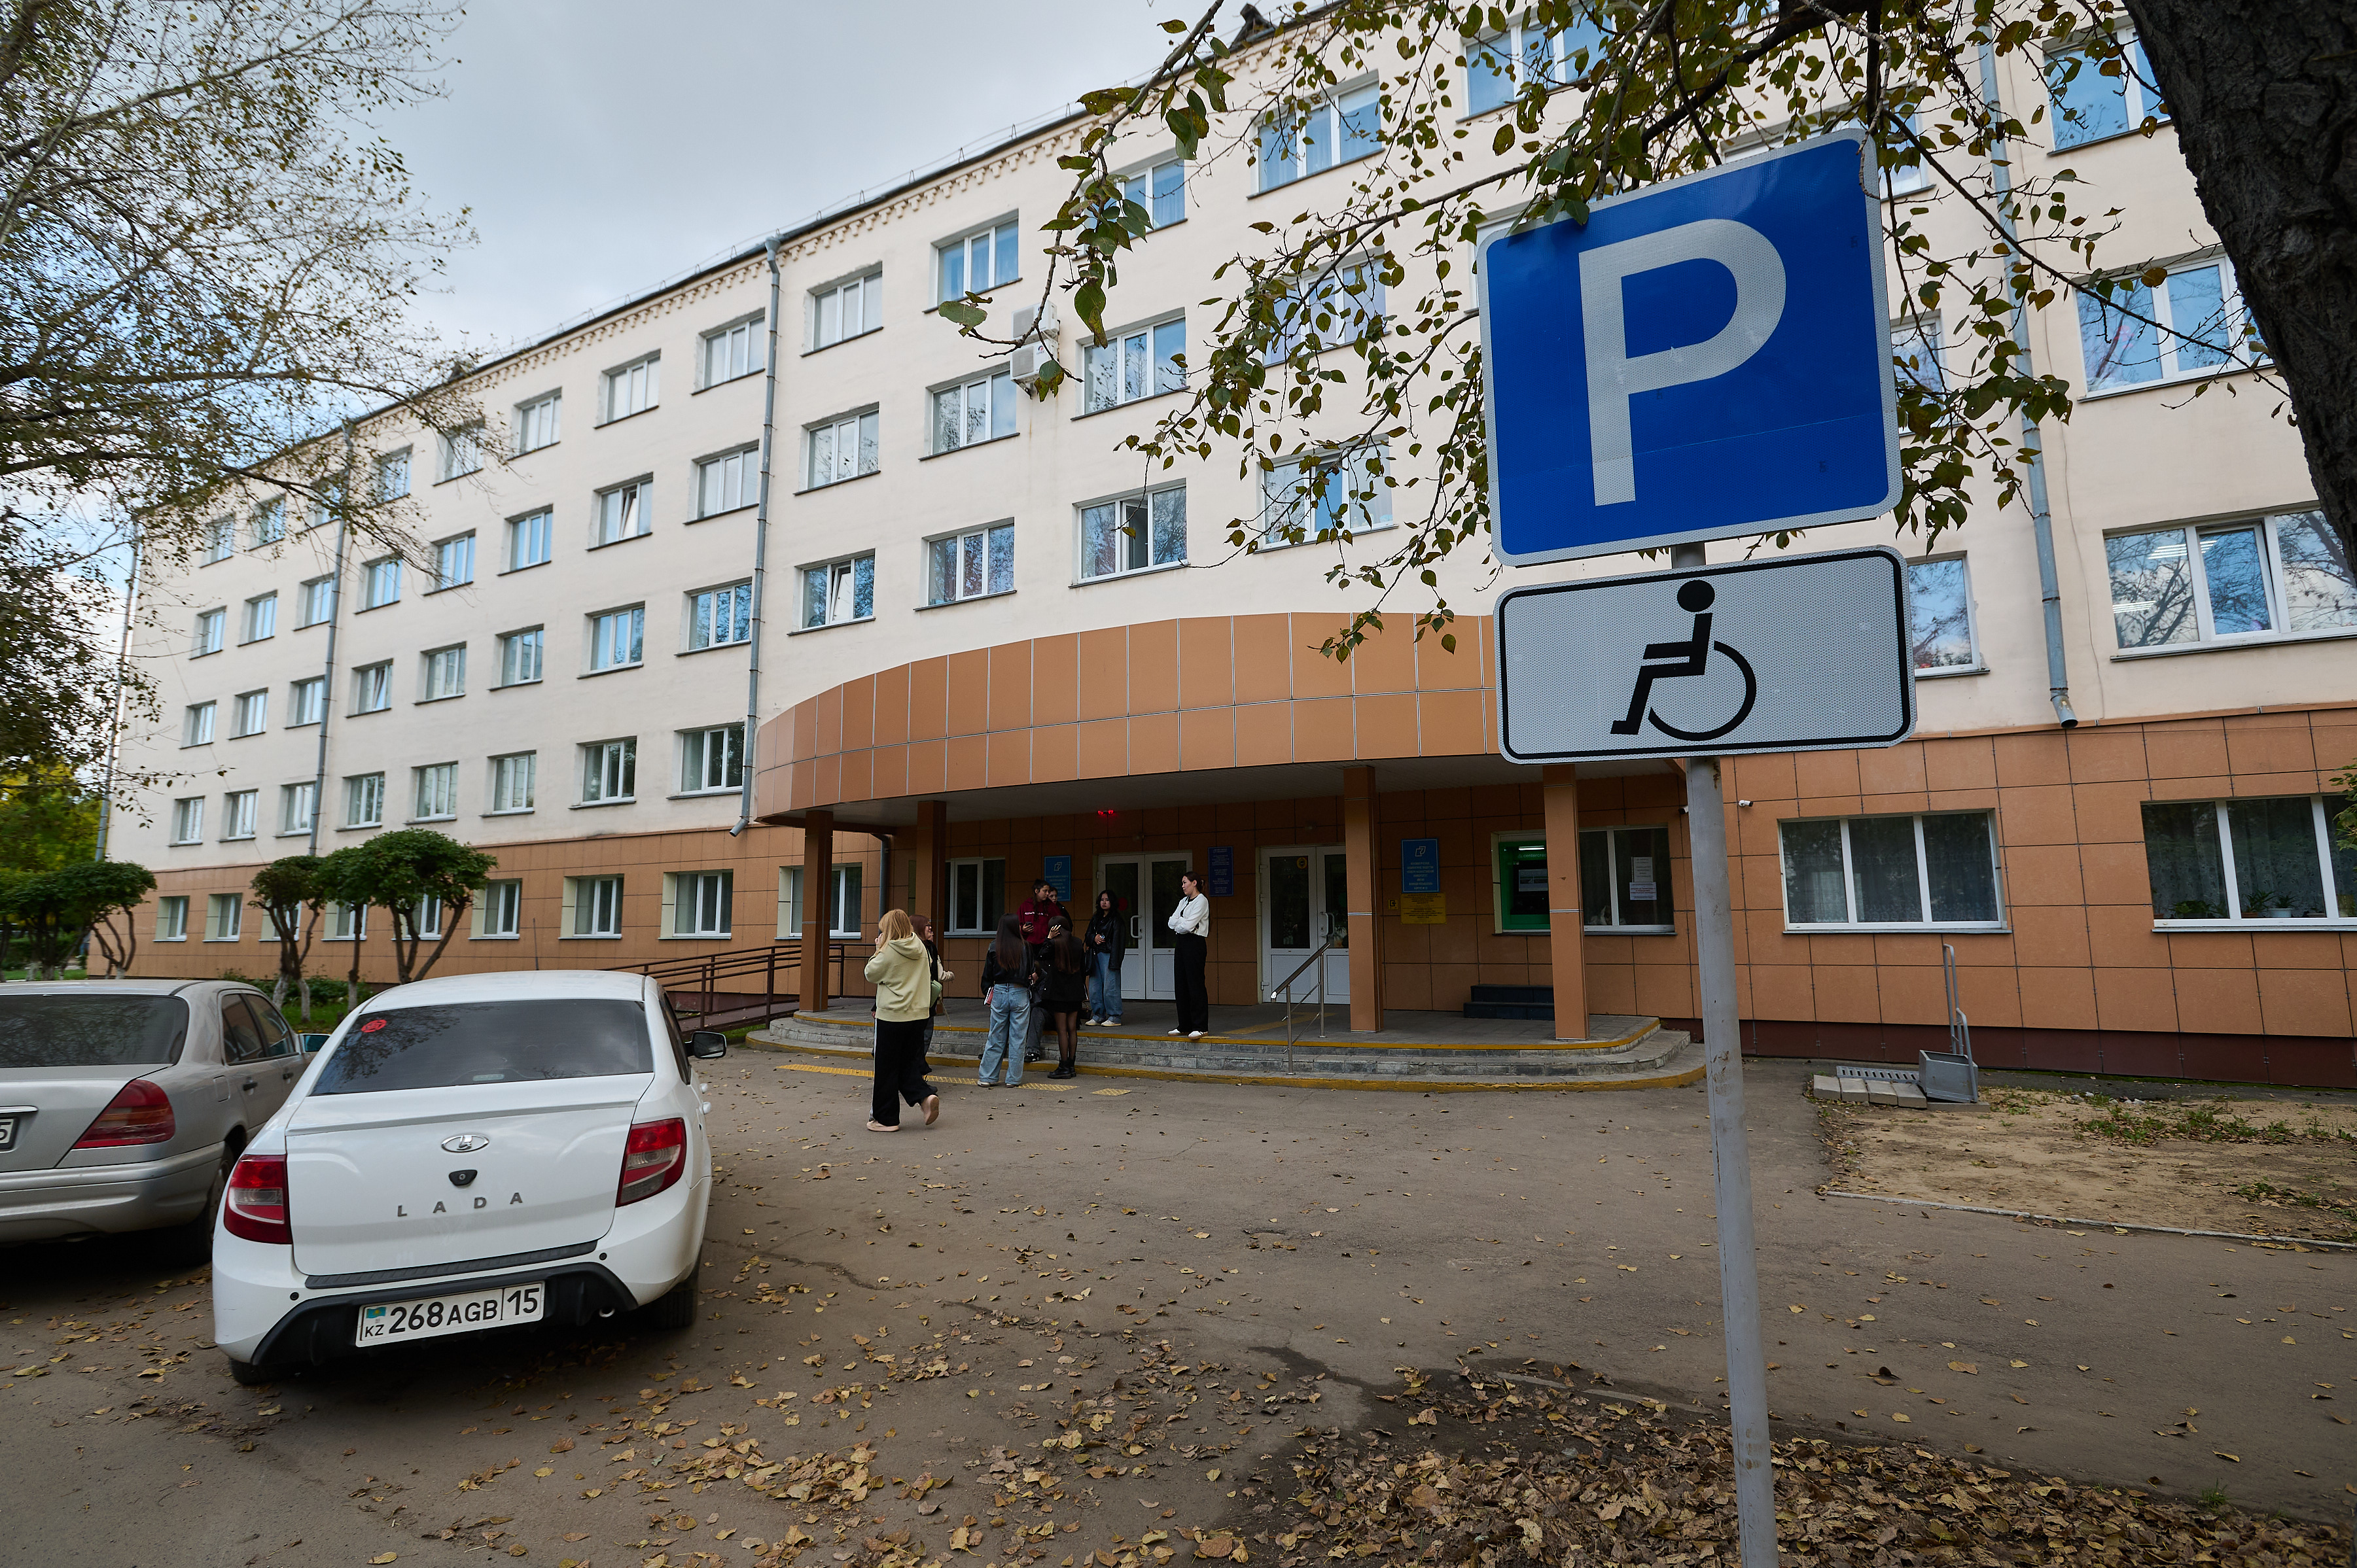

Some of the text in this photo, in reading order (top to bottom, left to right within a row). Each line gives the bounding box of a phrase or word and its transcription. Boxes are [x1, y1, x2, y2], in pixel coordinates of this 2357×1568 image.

[1578, 218, 1786, 506] P
[397, 1193, 523, 1217] LADA
[364, 1324, 384, 1337] KZ
[507, 1287, 540, 1315] 15
